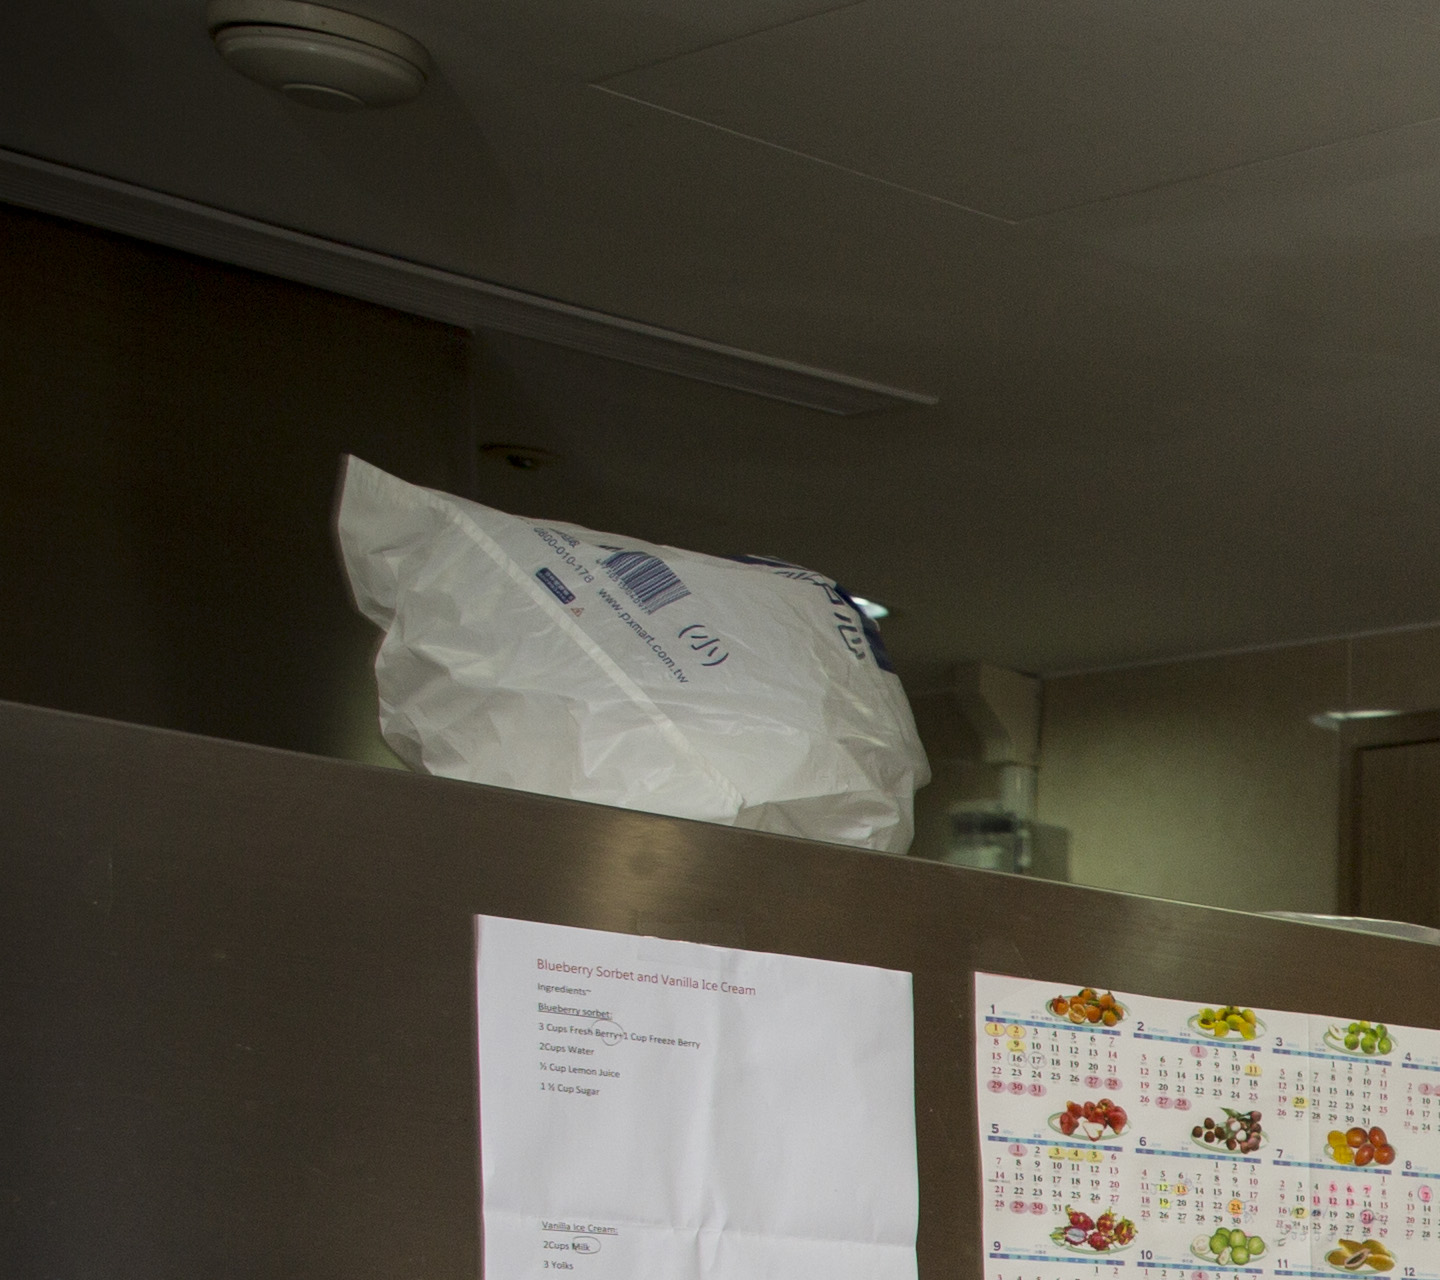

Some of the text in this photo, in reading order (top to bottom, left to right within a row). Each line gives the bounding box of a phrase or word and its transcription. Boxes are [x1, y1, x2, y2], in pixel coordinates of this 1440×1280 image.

[599, 588, 689, 683] www.pxmart.com.tw
[537, 959, 756, 996] Blueberry Sorbet and Vanilla Ice Cream
[538, 1003, 581, 1016] Blueberry
[990, 1004, 995, 1014] 1
[1137, 1022, 1144, 1031] 2
[538, 1023, 544, 1031] 3
[546, 1023, 568, 1034] Cups
[570, 1026, 593, 1036] Fresh
[630, 1032, 647, 1043] Cup
[649, 1034, 676, 1046] Freeze
[677, 1038, 701, 1049] Berry
[1276, 1037, 1283, 1047] 3
[539, 1042, 595, 1056] 2Cups Water
[1070, 1046, 1078, 1054] 12
[992, 1052, 1002, 1060] 15
[1012, 1054, 1022, 1062] 16
[1032, 1056, 1041, 1064] 17
[1051, 1058, 1060, 1066] 18
[1070, 1060, 1079, 1068] 19
[1405, 1052, 1411, 1061] 4
[549, 1063, 566, 1073] Cup
[568, 1065, 597, 1075] Lemon
[598, 1069, 621, 1079] Juice
[992, 1066, 1001, 1074] 22
[992, 1080, 1002, 1088] 29
[540, 1082, 546, 1090] 1
[557, 1084, 574, 1094] Cup
[575, 1085, 600, 1097] Sugar
[992, 1124, 999, 1134] 5
[1140, 1137, 1147, 1146] 6
[1276, 1149, 1283, 1158] 7
[1406, 1161, 1412, 1169] 8
[542, 1221, 571, 1231] Vanilla
[573, 1223, 585, 1232] Ice
[543, 1241, 590, 1251] 2Cups Milk
[993, 1241, 1001, 1251] 9
[1141, 1250, 1152, 1260] 10
[544, 1261, 549, 1269] 3
[1278, 1258, 1288, 1268] 11
[1404, 1267, 1415, 1277] 12
